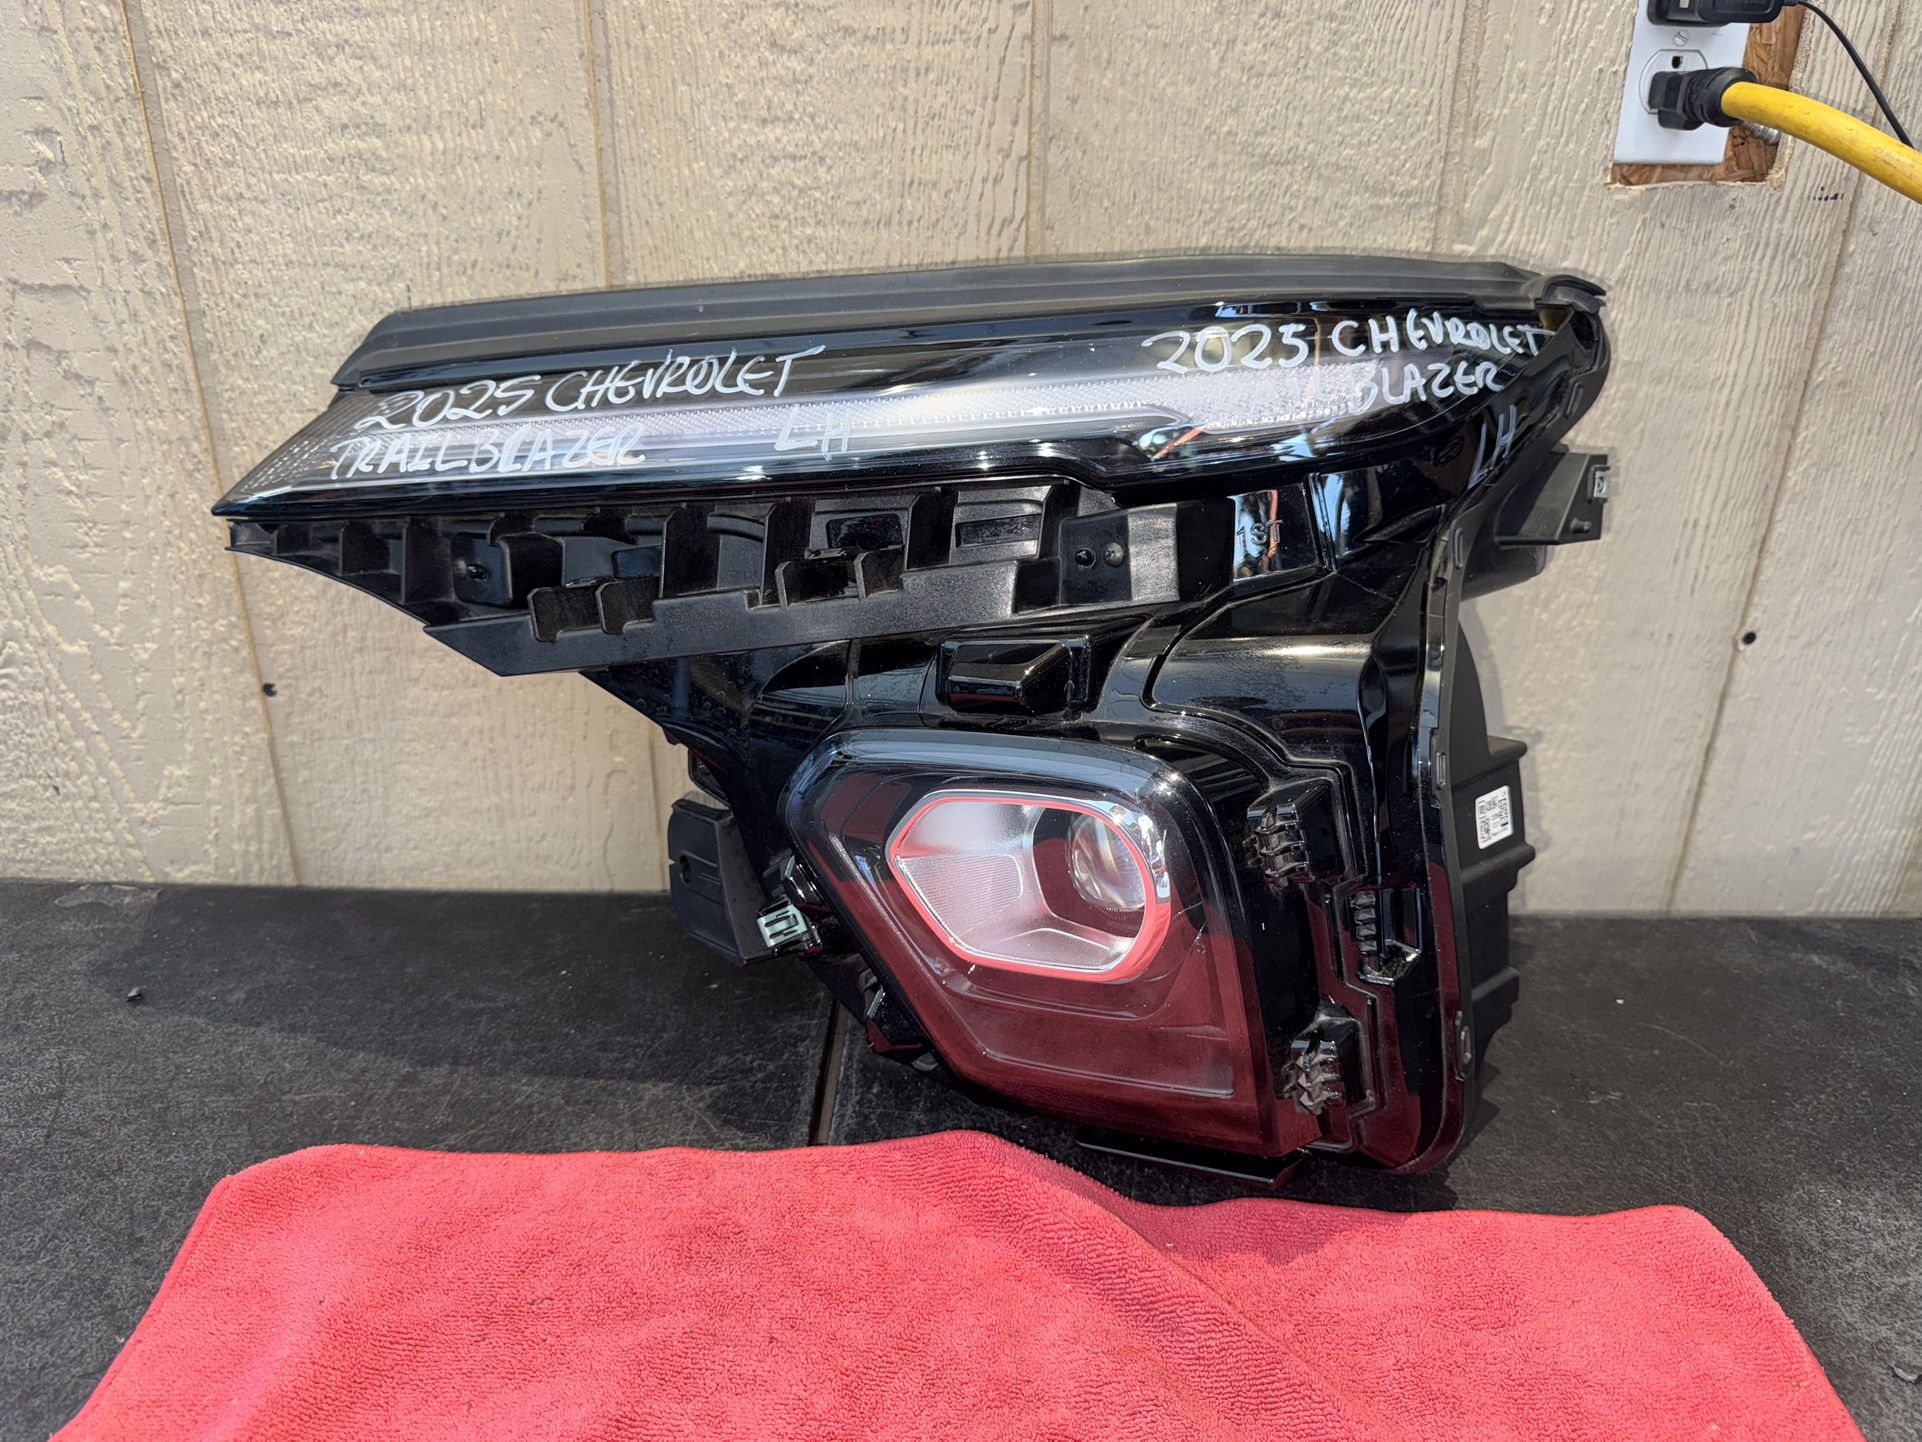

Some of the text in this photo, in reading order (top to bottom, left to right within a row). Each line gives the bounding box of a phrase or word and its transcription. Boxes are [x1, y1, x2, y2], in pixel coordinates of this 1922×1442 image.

[1142, 308, 1554, 373] 2025 CHEVROLET
[355, 345, 826, 430] 2025 CHEVROLET
